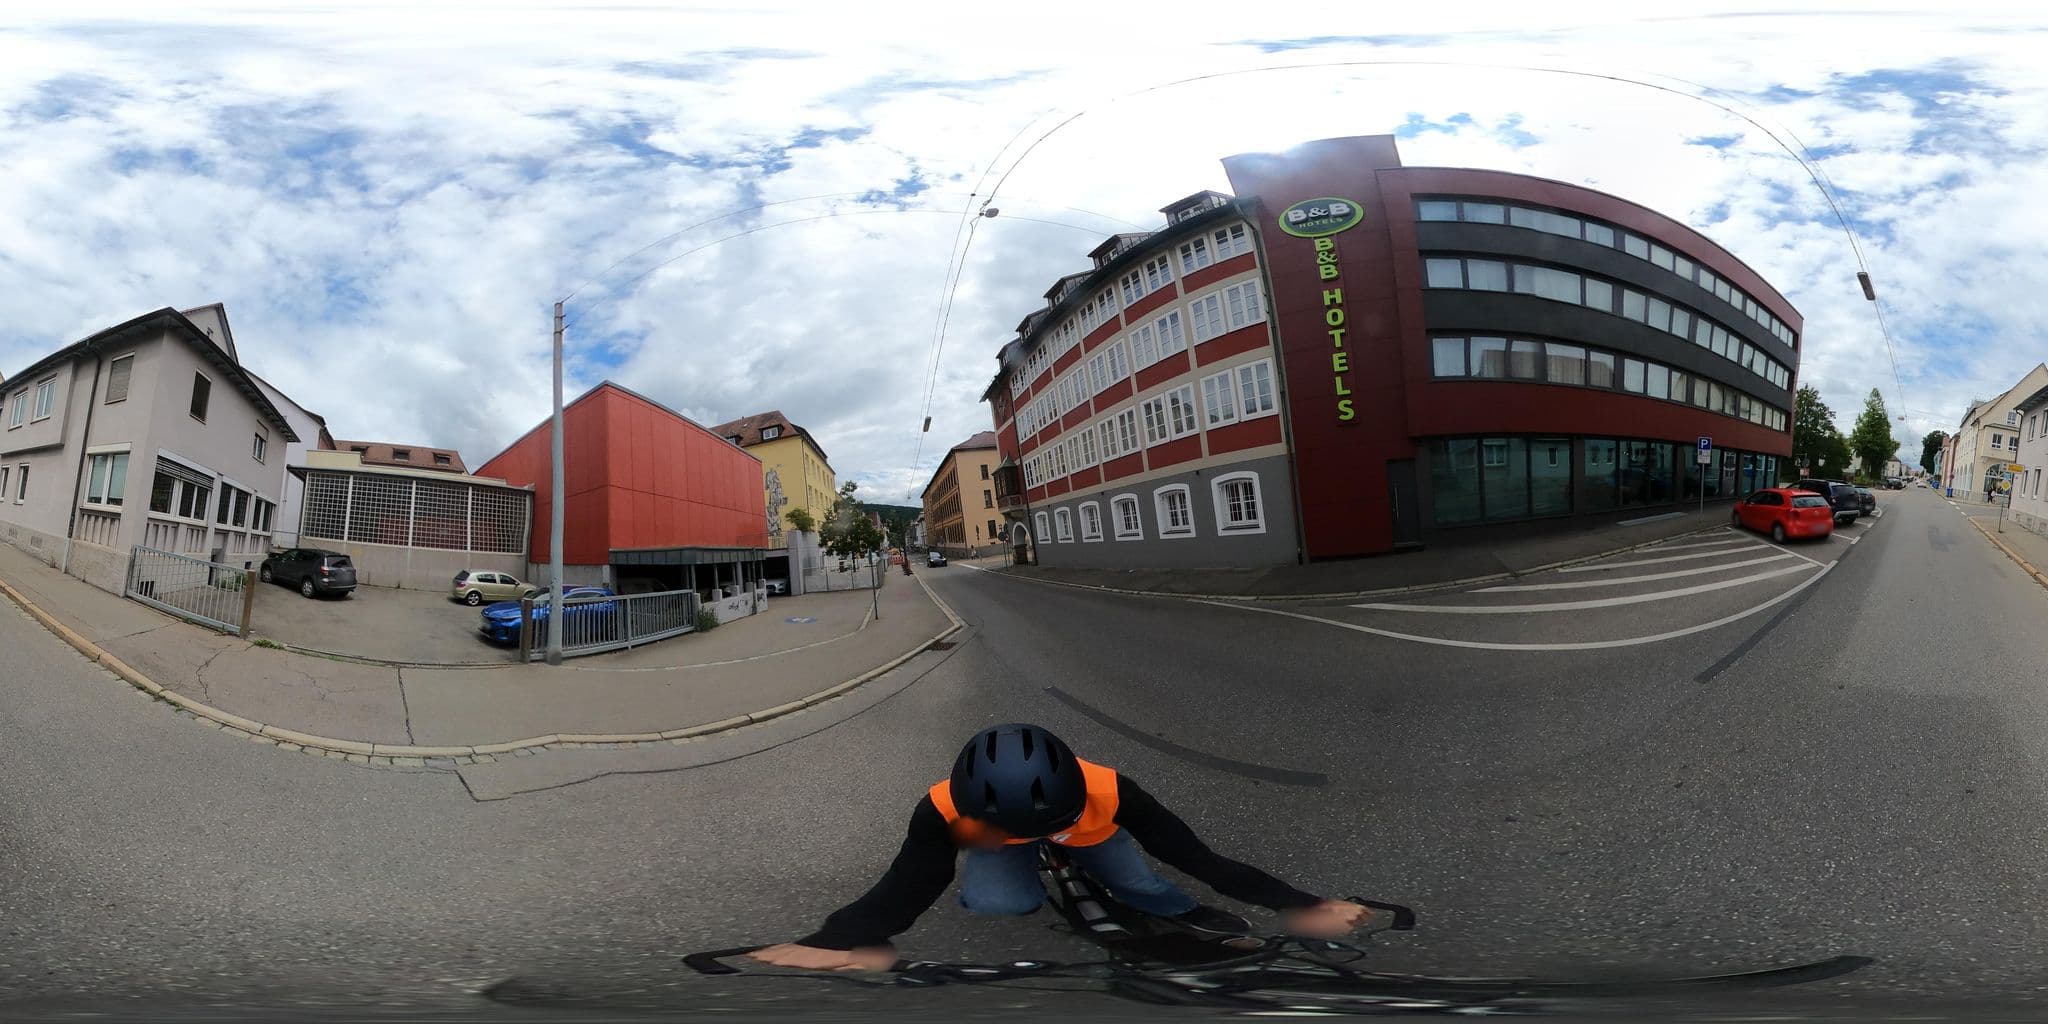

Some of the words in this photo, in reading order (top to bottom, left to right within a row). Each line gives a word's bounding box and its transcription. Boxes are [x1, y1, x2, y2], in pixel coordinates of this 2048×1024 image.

[1287, 202, 1350, 223] B&B
[1298, 217, 1344, 229] HOTELS
[1314, 238, 1338, 280] B&B
[1322, 288, 1355, 422] HOTELS
[1701, 439, 1708, 448] P
